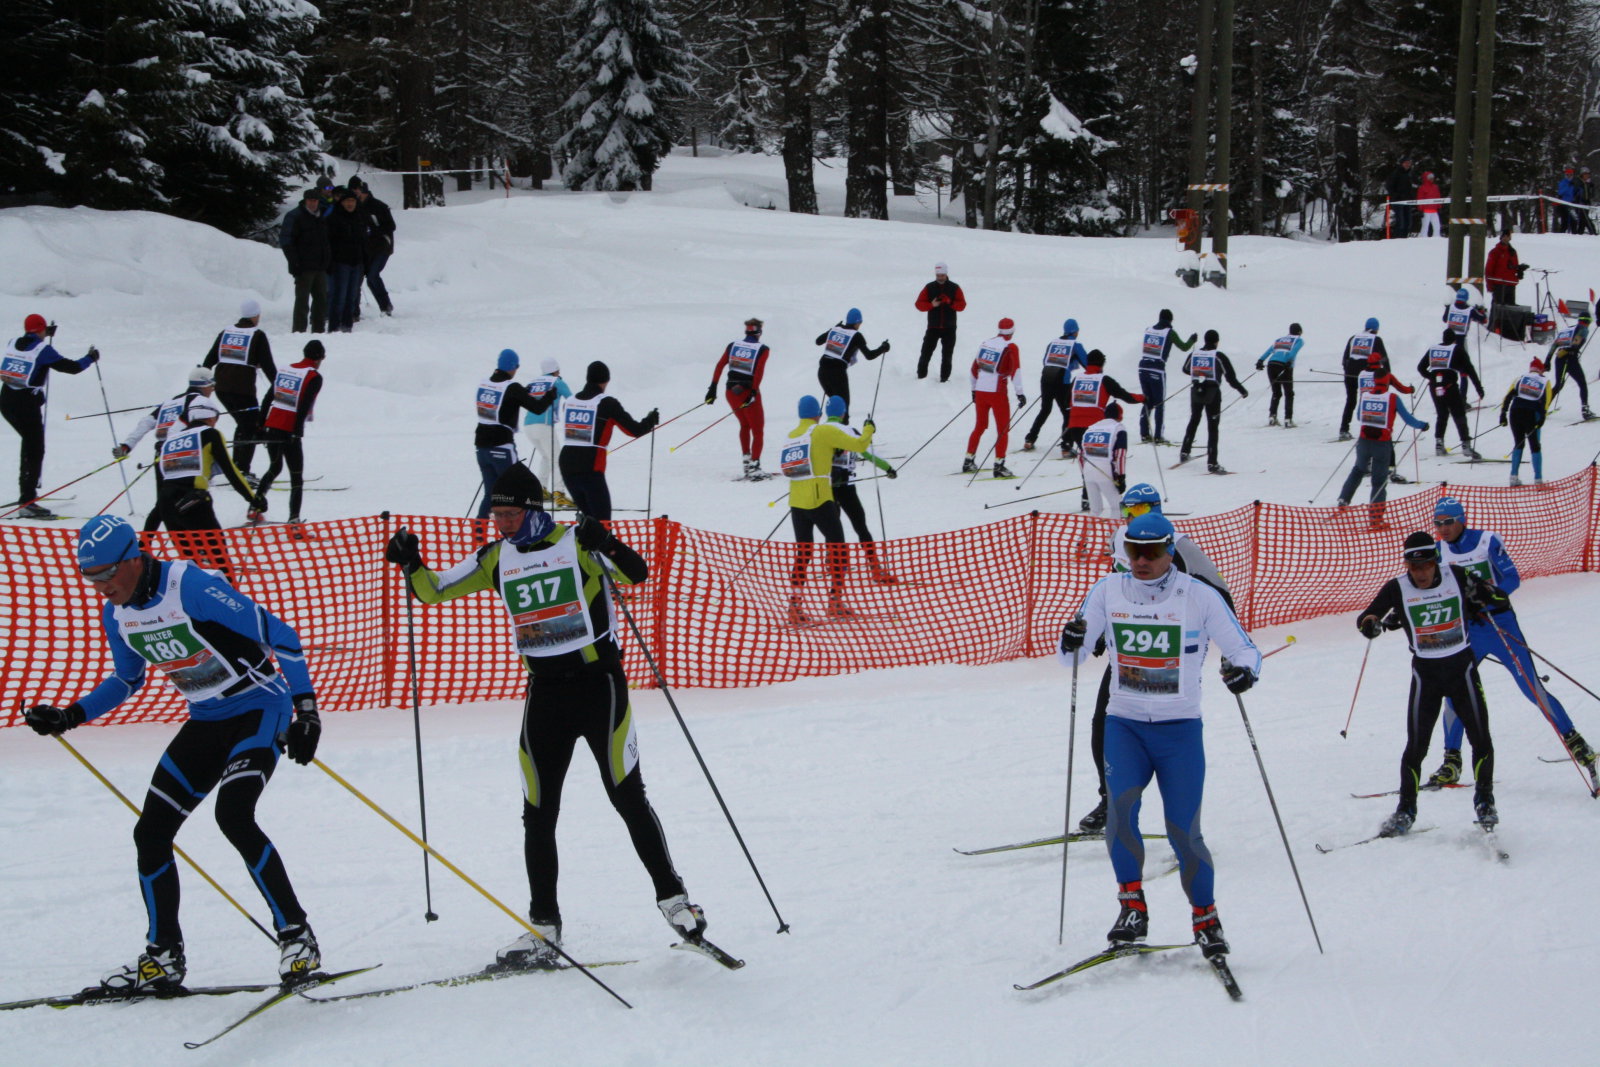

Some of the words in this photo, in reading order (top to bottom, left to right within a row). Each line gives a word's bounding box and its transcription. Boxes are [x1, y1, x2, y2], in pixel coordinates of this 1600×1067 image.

[227, 337, 244, 346] 683
[832, 334, 845, 344] 675
[735, 349, 752, 359] 689
[7, 362, 26, 373] 755
[1196, 359, 1210, 367] 759
[279, 379, 296, 389] 663
[1079, 383, 1094, 391] 710
[480, 393, 497, 404] 686
[1365, 402, 1383, 411] 859
[568, 410, 591, 423] 840
[168, 436, 194, 451] 836
[1088, 434, 1104, 443] 719
[785, 449, 804, 462] 680
[516, 576, 561, 608] 317
[1420, 607, 1452, 626] 277
[142, 629, 174, 643] WALTER
[1121, 629, 1170, 653] 294
[144, 638, 189, 662] 180
